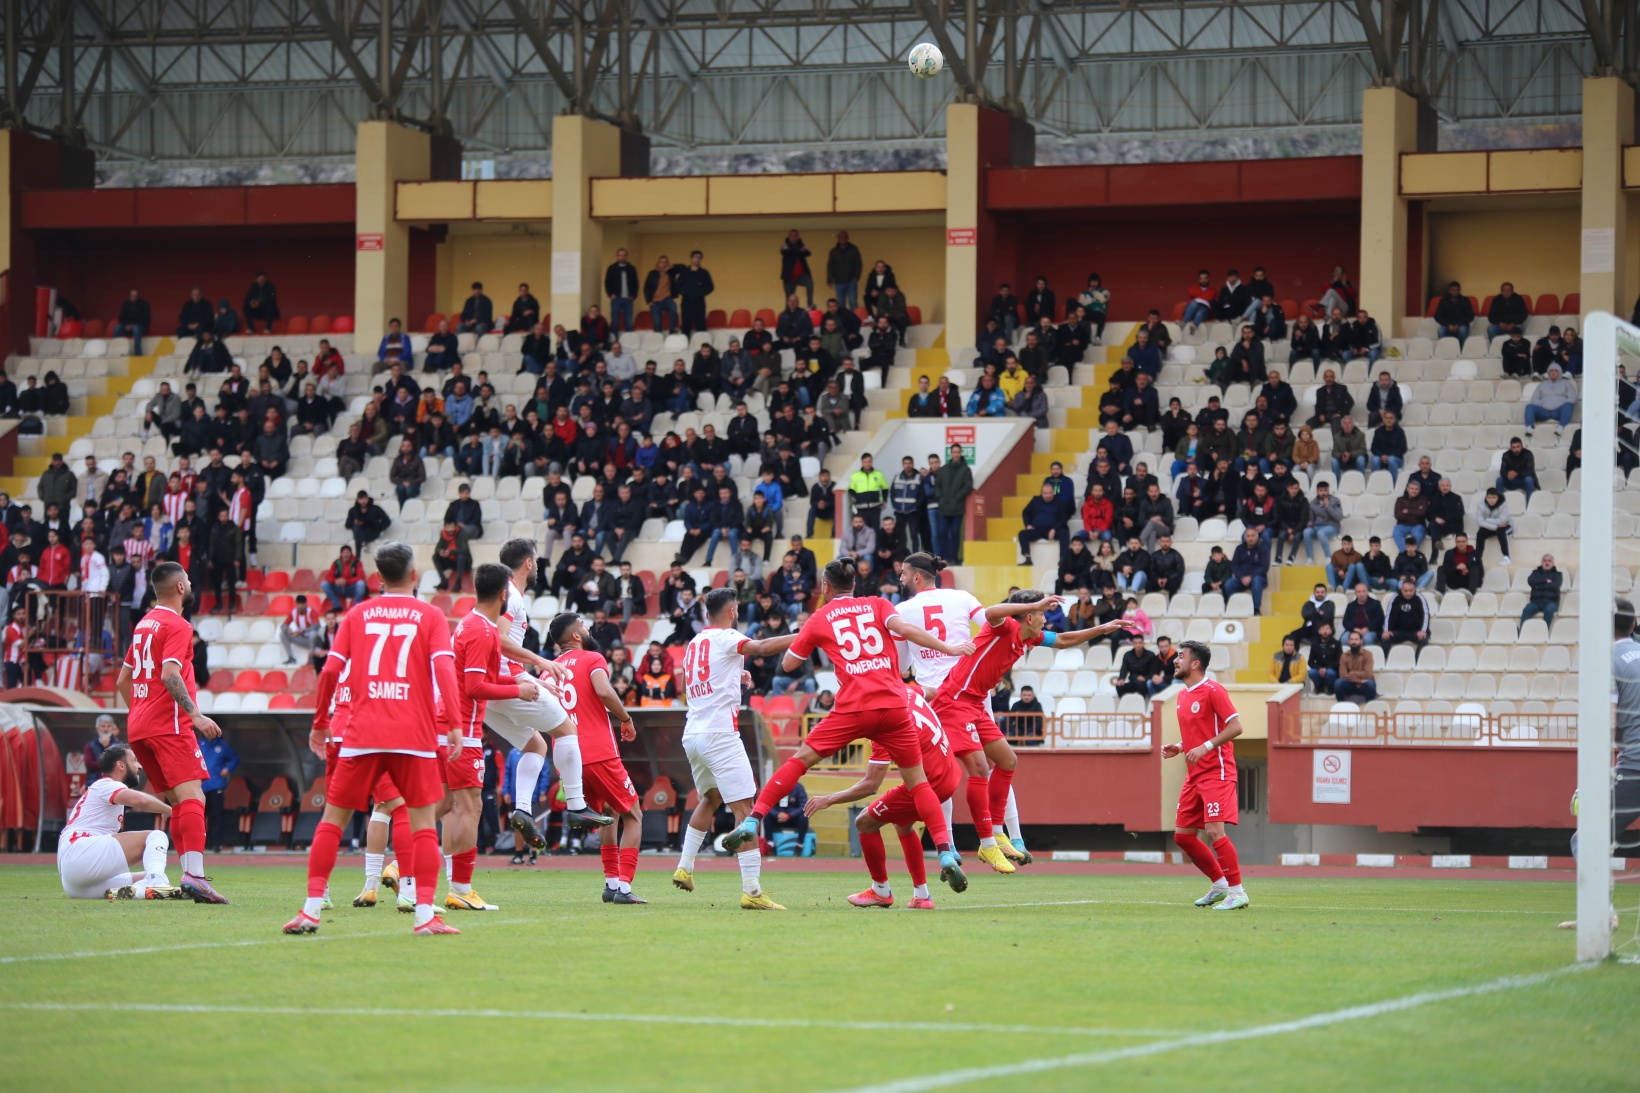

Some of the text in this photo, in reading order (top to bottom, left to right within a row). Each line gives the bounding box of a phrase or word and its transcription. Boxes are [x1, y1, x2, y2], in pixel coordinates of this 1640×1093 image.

[363, 606, 423, 623] KARAMAN FK
[825, 604, 873, 622] KARAMAN FK
[923, 604, 946, 642] 5
[831, 612, 884, 661] 55
[132, 633, 155, 680] 54
[365, 622, 418, 678] 77
[686, 638, 710, 686] 99
[368, 681, 410, 700] SAMET
[689, 681, 713, 699] KOCA
[875, 800, 889, 813] 17
[1207, 802, 1220, 814] 23
